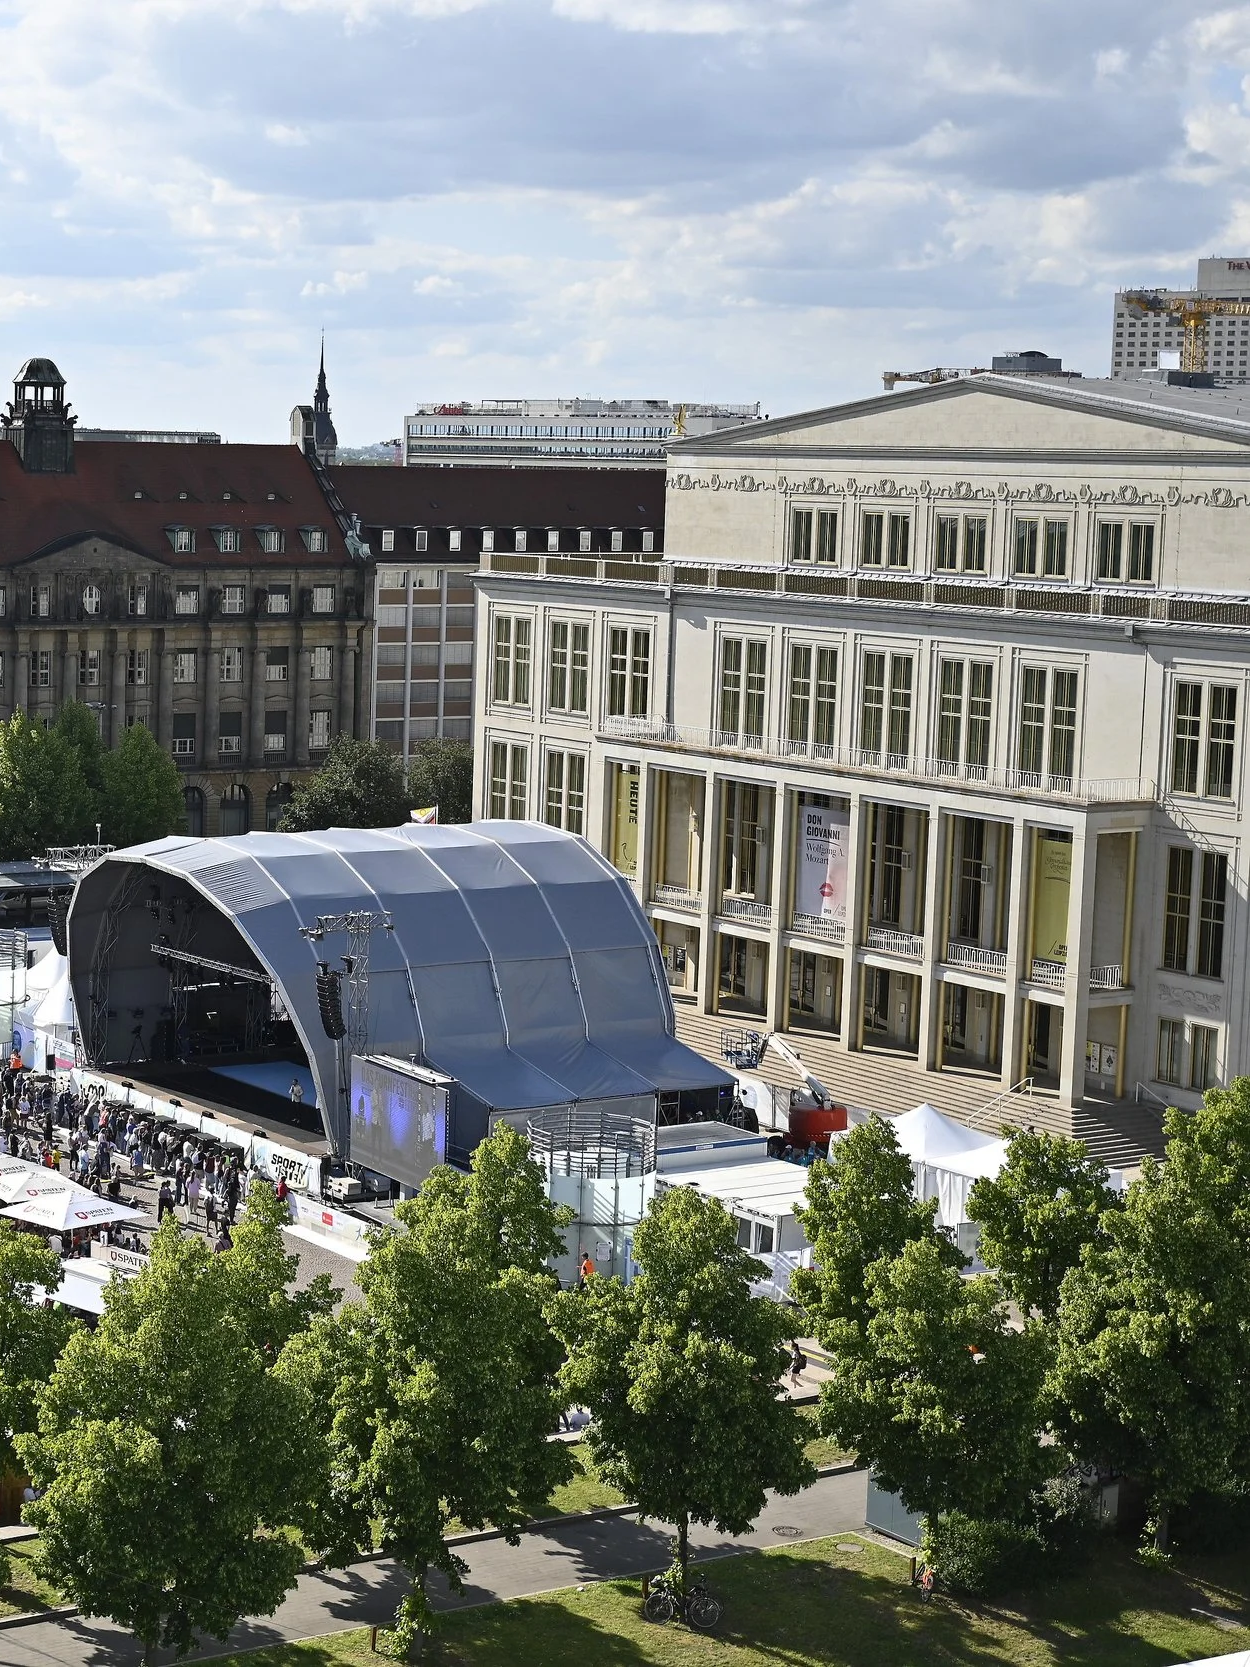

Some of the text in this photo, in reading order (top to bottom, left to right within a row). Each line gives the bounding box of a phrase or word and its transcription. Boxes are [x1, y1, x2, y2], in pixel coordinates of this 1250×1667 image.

[1226, 260, 1245, 270] THE
[629, 780, 639, 825] HEUTE
[807, 814, 823, 826] DON
[806, 826, 840, 840] GIOVANNI
[806, 843, 837, 858] Wolfgang
[806, 853, 829, 865] Mozart
[0, 1164, 26, 1173] SPATEN
[270, 1153, 303, 1173] SPORT
[85, 1206, 113, 1216] SPATEN
[101, 1234, 106, 1246] 1
